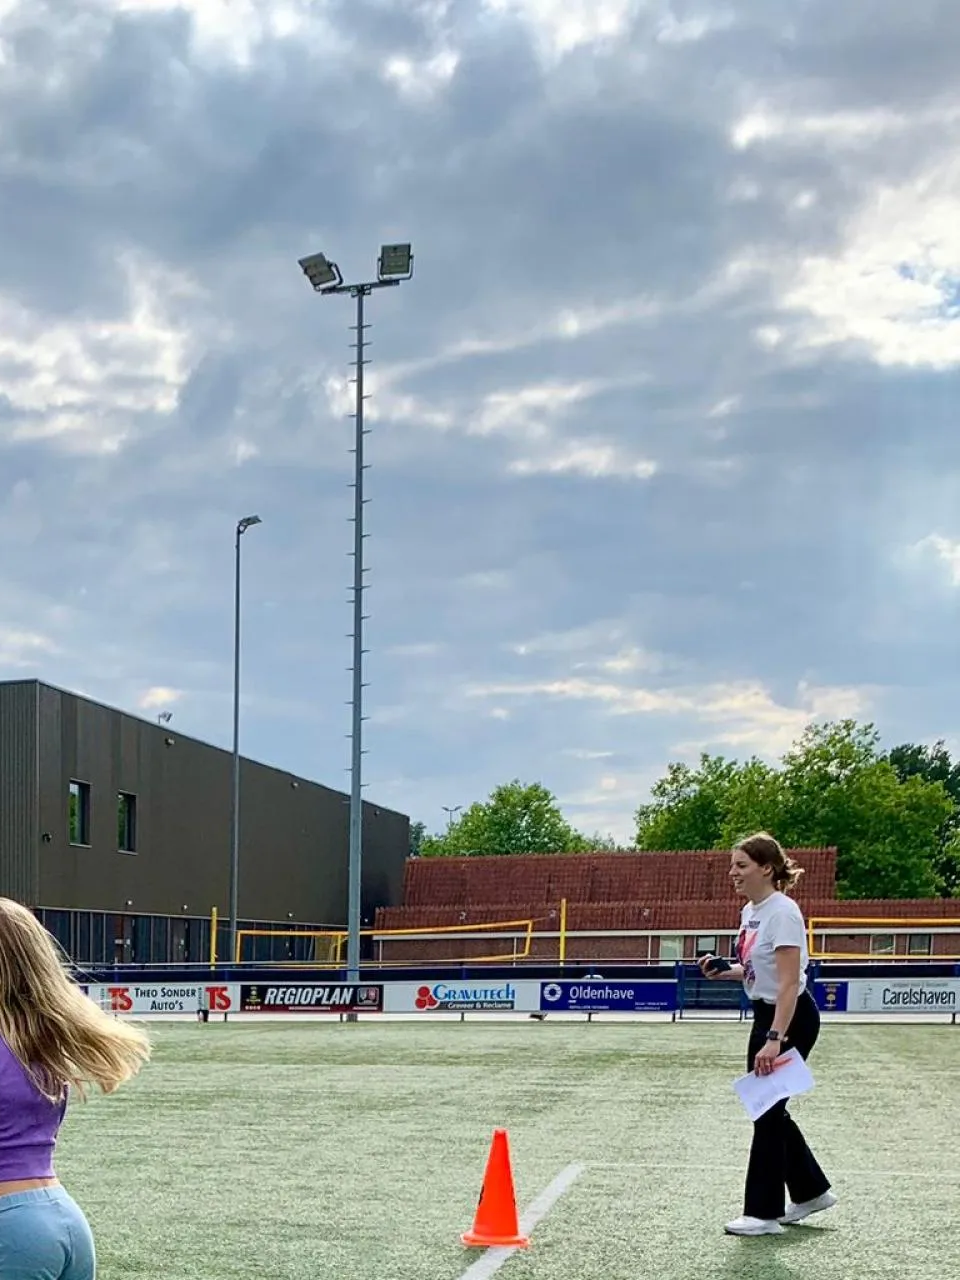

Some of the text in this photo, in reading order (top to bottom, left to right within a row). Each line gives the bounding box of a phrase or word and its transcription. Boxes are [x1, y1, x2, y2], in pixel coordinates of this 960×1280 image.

[107, 987, 133, 1010] TS
[135, 987, 196, 998] THEO SONDER
[205, 986, 231, 1010] TS
[264, 987, 353, 1005] REGIOPLAN
[569, 986, 635, 1000] Oldenhave
[882, 988, 956, 1005] Carelshaven
